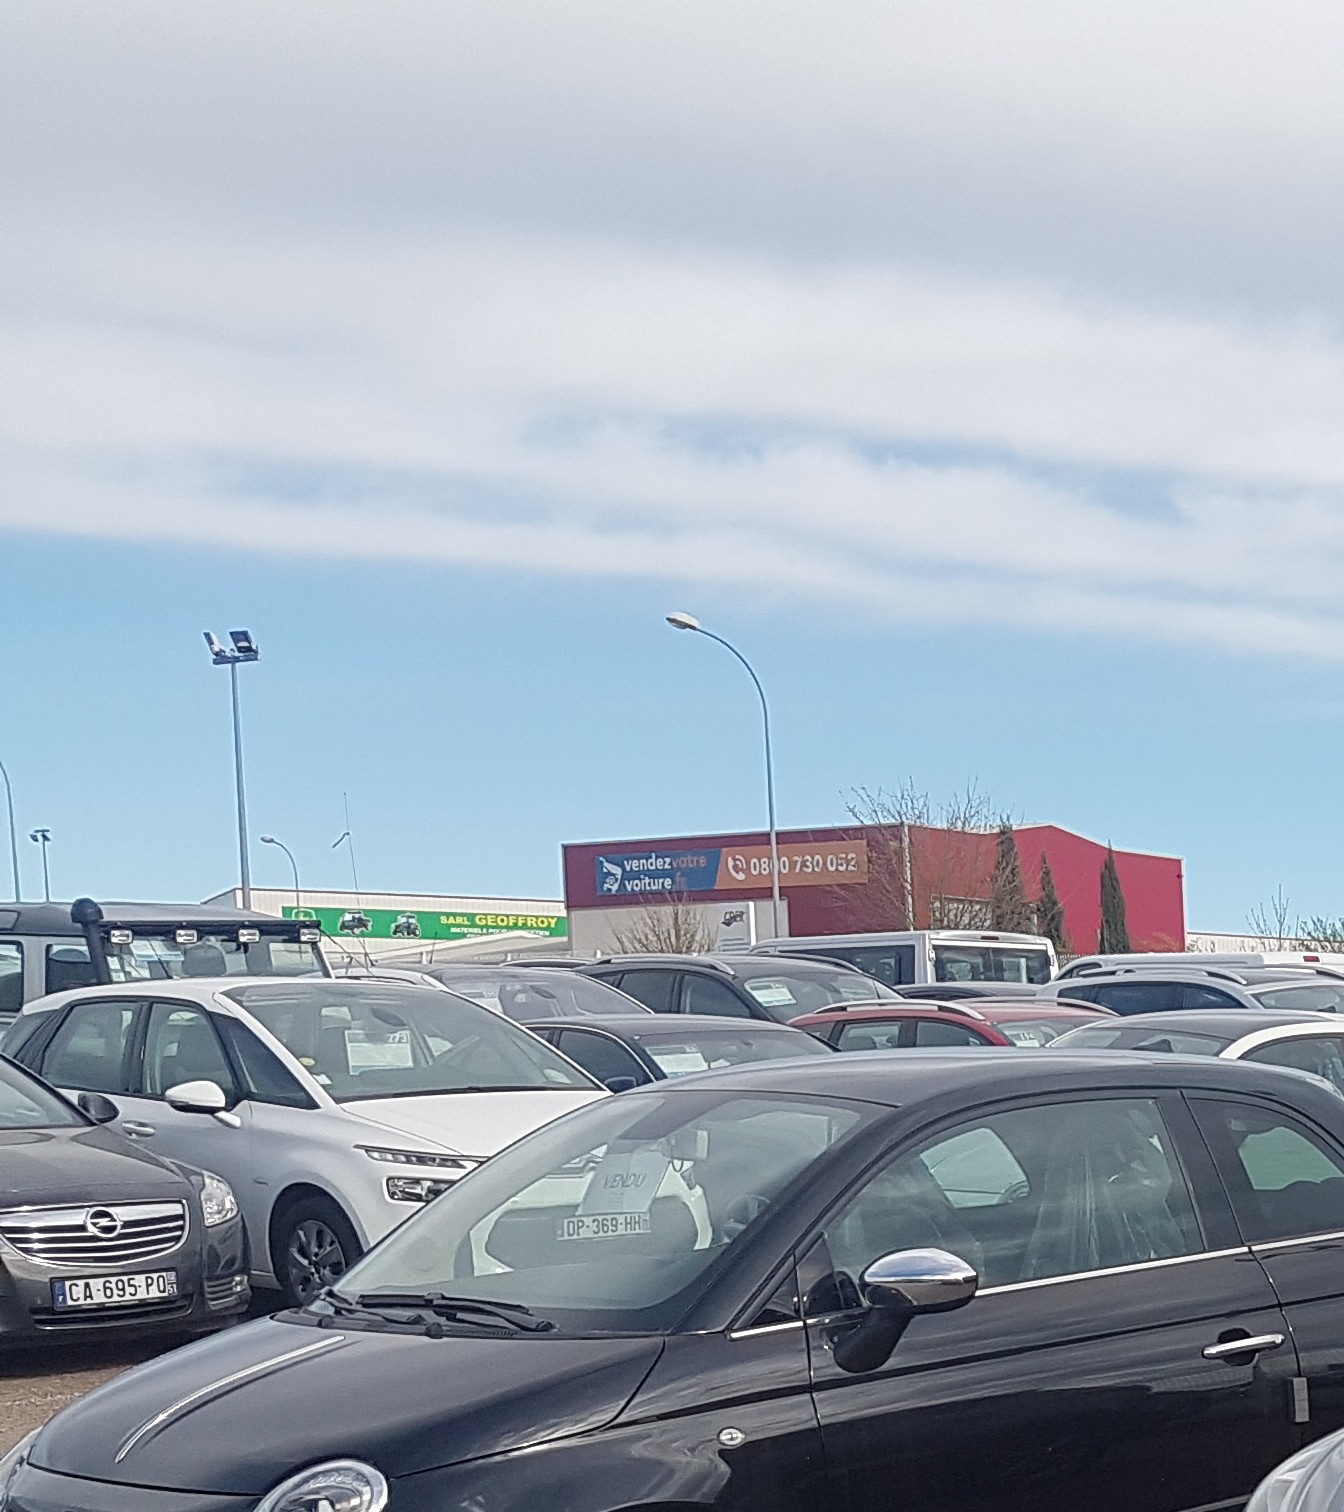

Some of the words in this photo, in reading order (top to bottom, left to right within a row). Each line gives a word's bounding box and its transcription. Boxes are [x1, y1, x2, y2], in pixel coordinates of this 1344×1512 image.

[794, 855, 823, 875] 730
[440, 915, 471, 925] SARL
[475, 914, 558, 928] GEOFFROY
[566, 1214, 642, 1238] DP-369-HH
